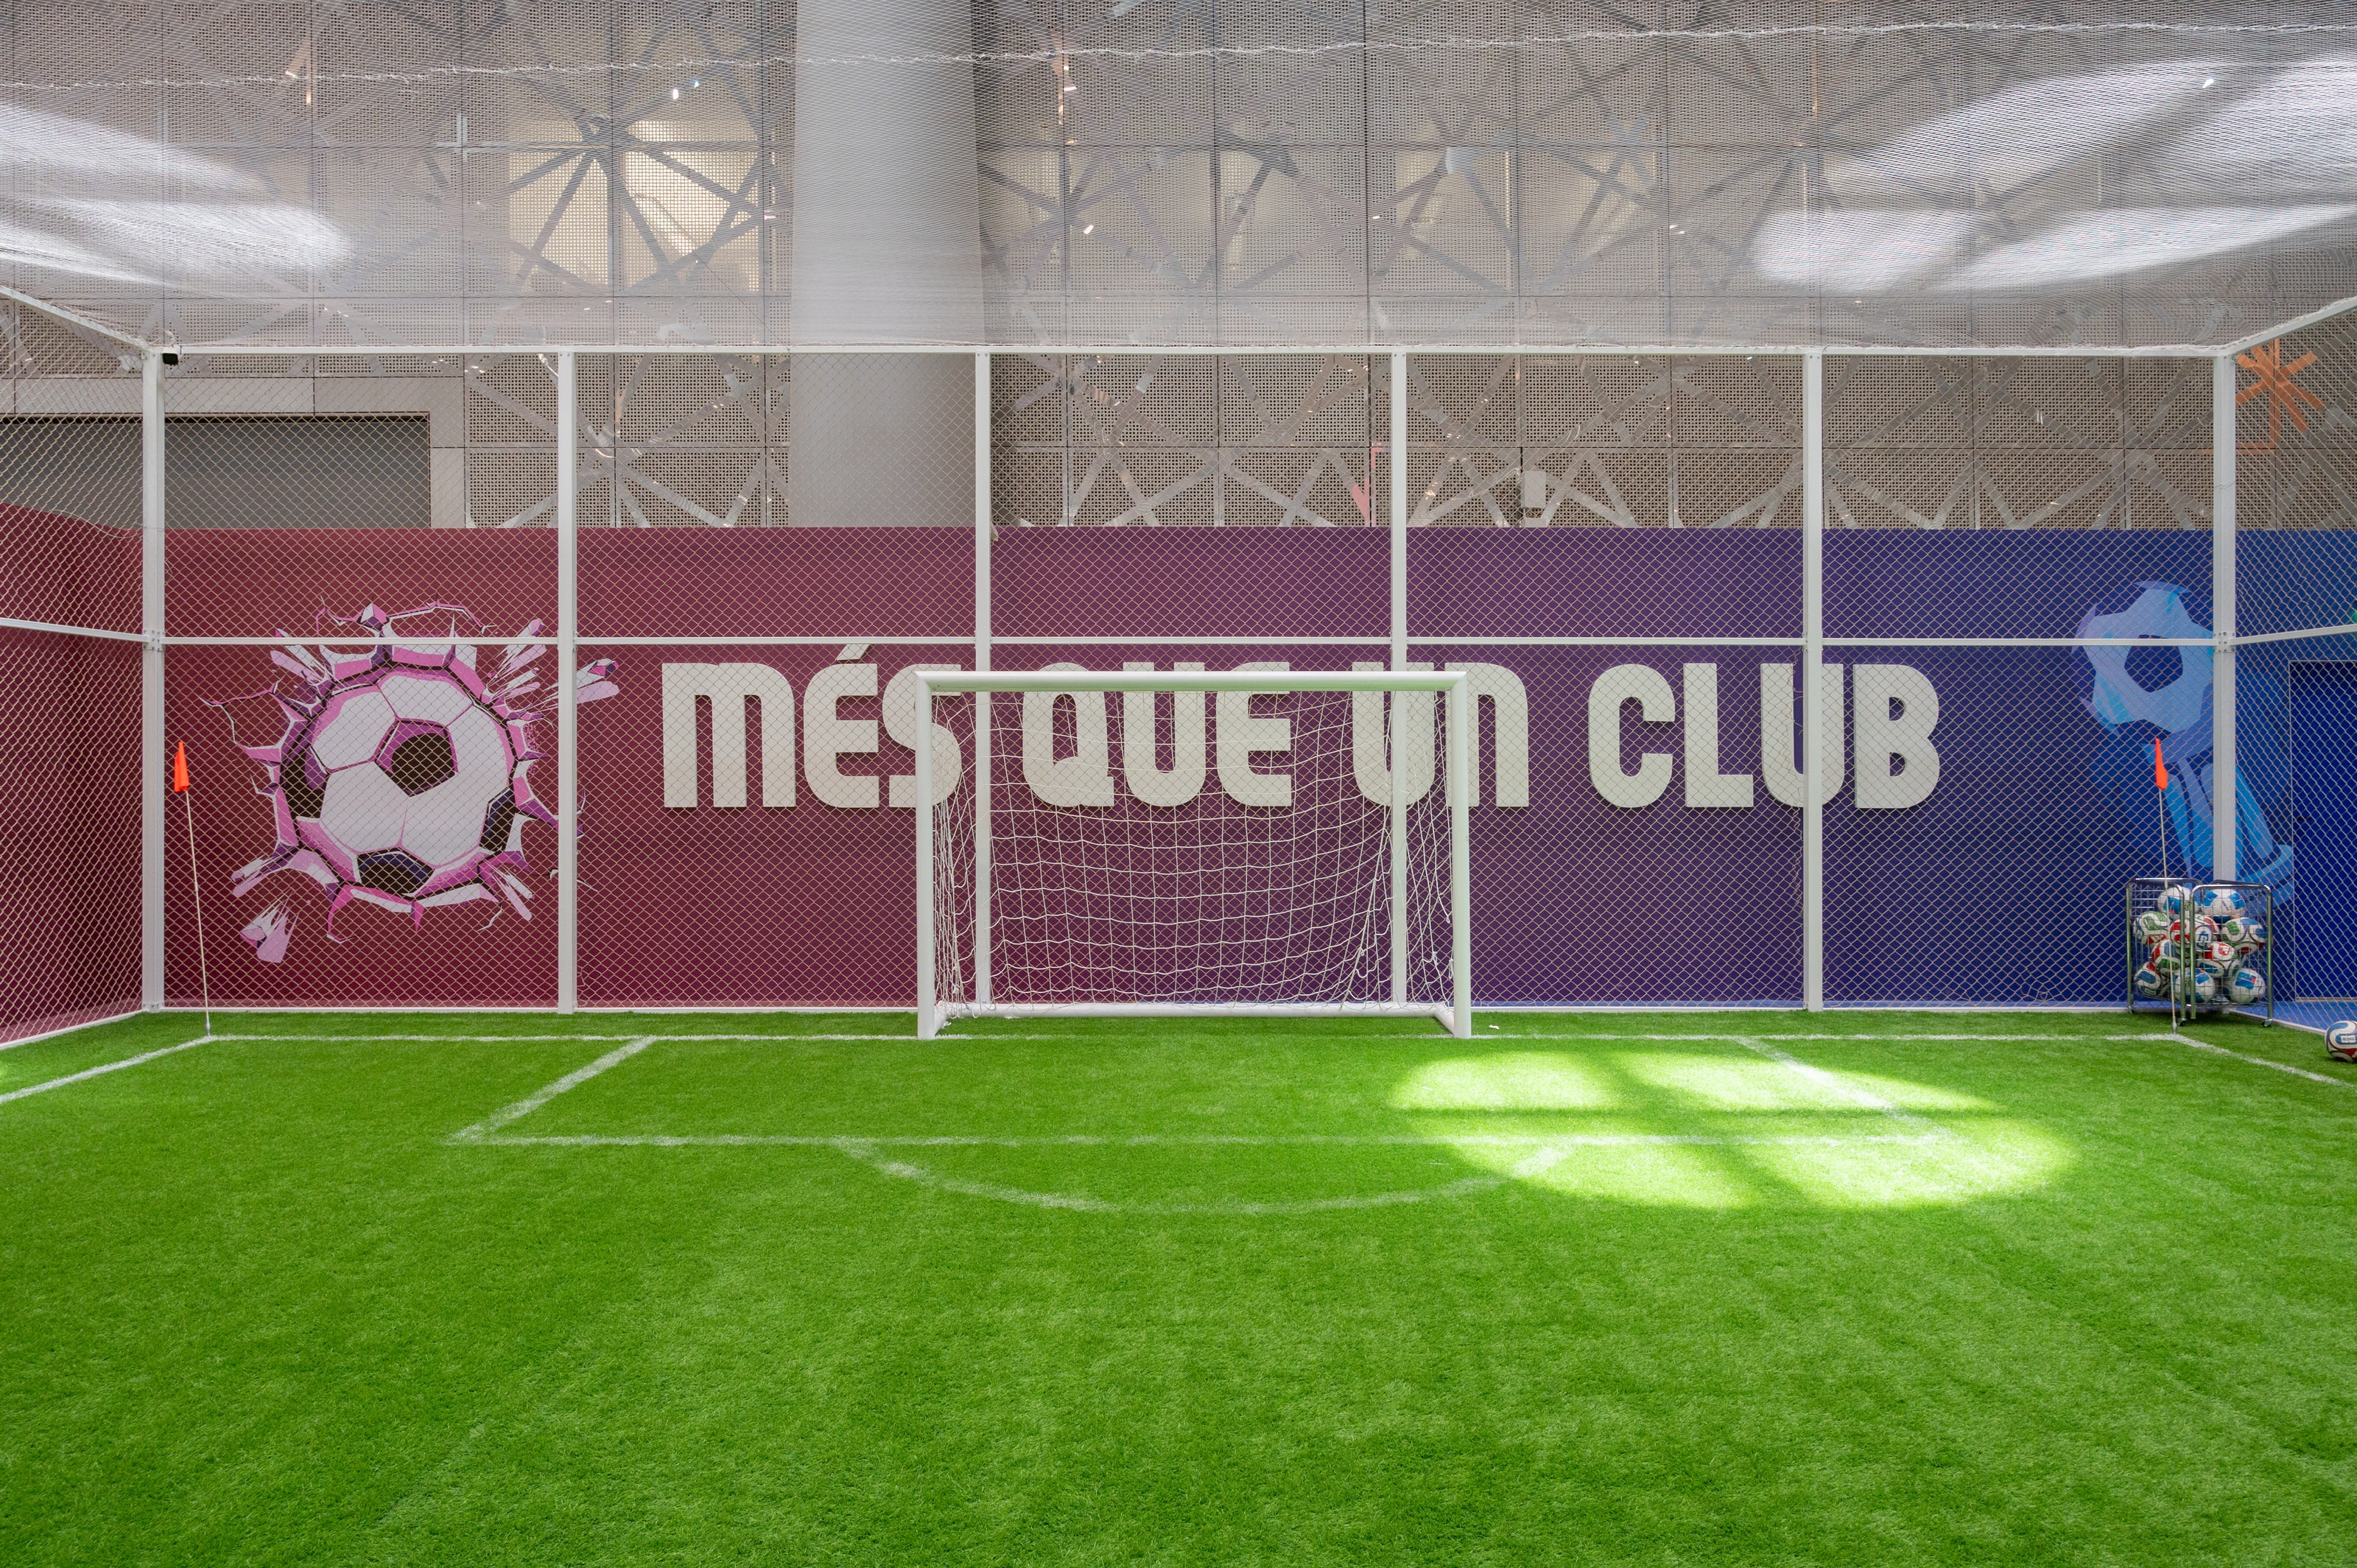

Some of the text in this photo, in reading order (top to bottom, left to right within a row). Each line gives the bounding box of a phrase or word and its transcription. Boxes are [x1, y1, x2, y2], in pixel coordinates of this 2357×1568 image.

[661, 643, 1940, 809] MÉS QUE UN CLUB
